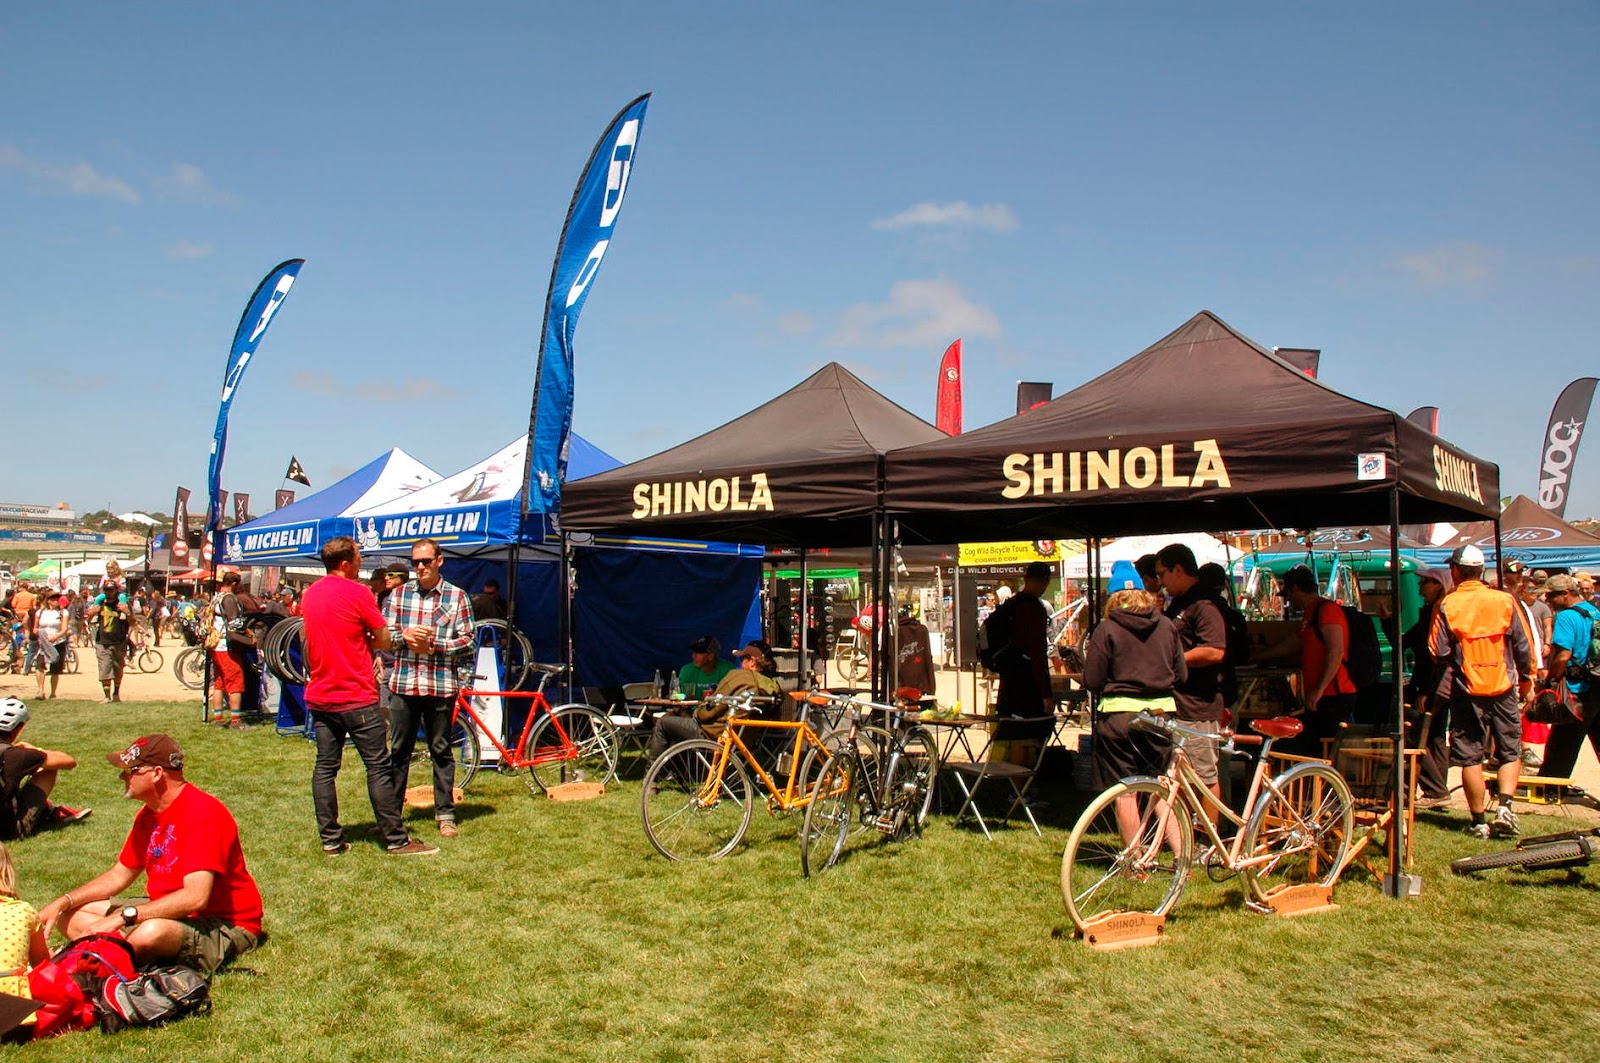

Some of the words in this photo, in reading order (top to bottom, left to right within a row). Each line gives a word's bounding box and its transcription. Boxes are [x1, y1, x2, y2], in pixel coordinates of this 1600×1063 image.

[1001, 439, 1232, 499] SHINOLA
[1433, 444, 1484, 505] SHINOLA
[1540, 421, 1578, 509] evoc
[631, 473, 775, 519] SHINOLA
[383, 512, 481, 537] MICHELIN
[244, 527, 314, 550] MICHELIN
[964, 548, 976, 556] Cog
[977, 547, 989, 555] Wild
[990, 546, 1011, 554] Bicycle
[1012, 545, 1029, 553] Tours
[990, 566, 1024, 574] BICYCLE
[1107, 917, 1147, 931] SHINOLA
